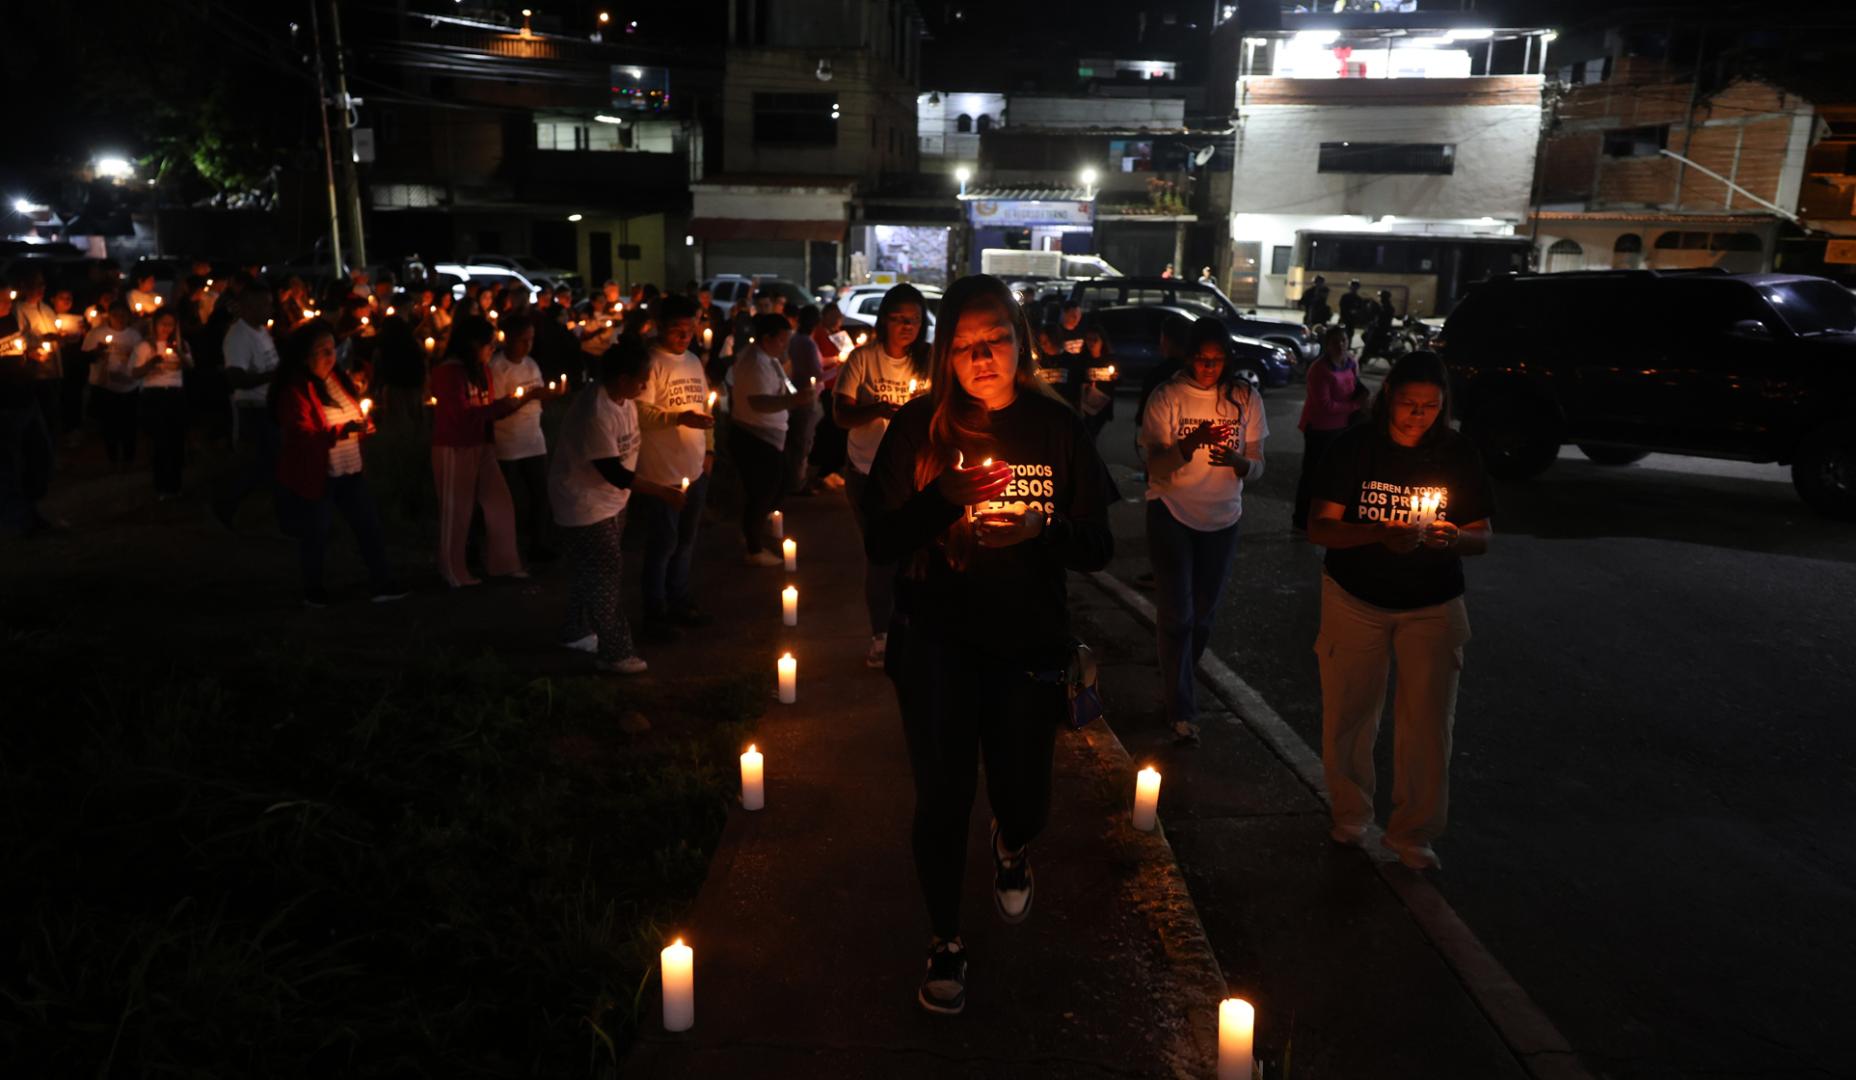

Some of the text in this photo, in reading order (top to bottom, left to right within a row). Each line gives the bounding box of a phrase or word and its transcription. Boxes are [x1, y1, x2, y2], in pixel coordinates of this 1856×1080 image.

[1008, 464, 1053, 477] TODOS
[1000, 479, 1054, 498] ESOS
[1362, 481, 1448, 496] LIBEREN A TODOS
[1360, 491, 1448, 509] LOS PRS
[1358, 505, 1447, 524] POLÍTIS
